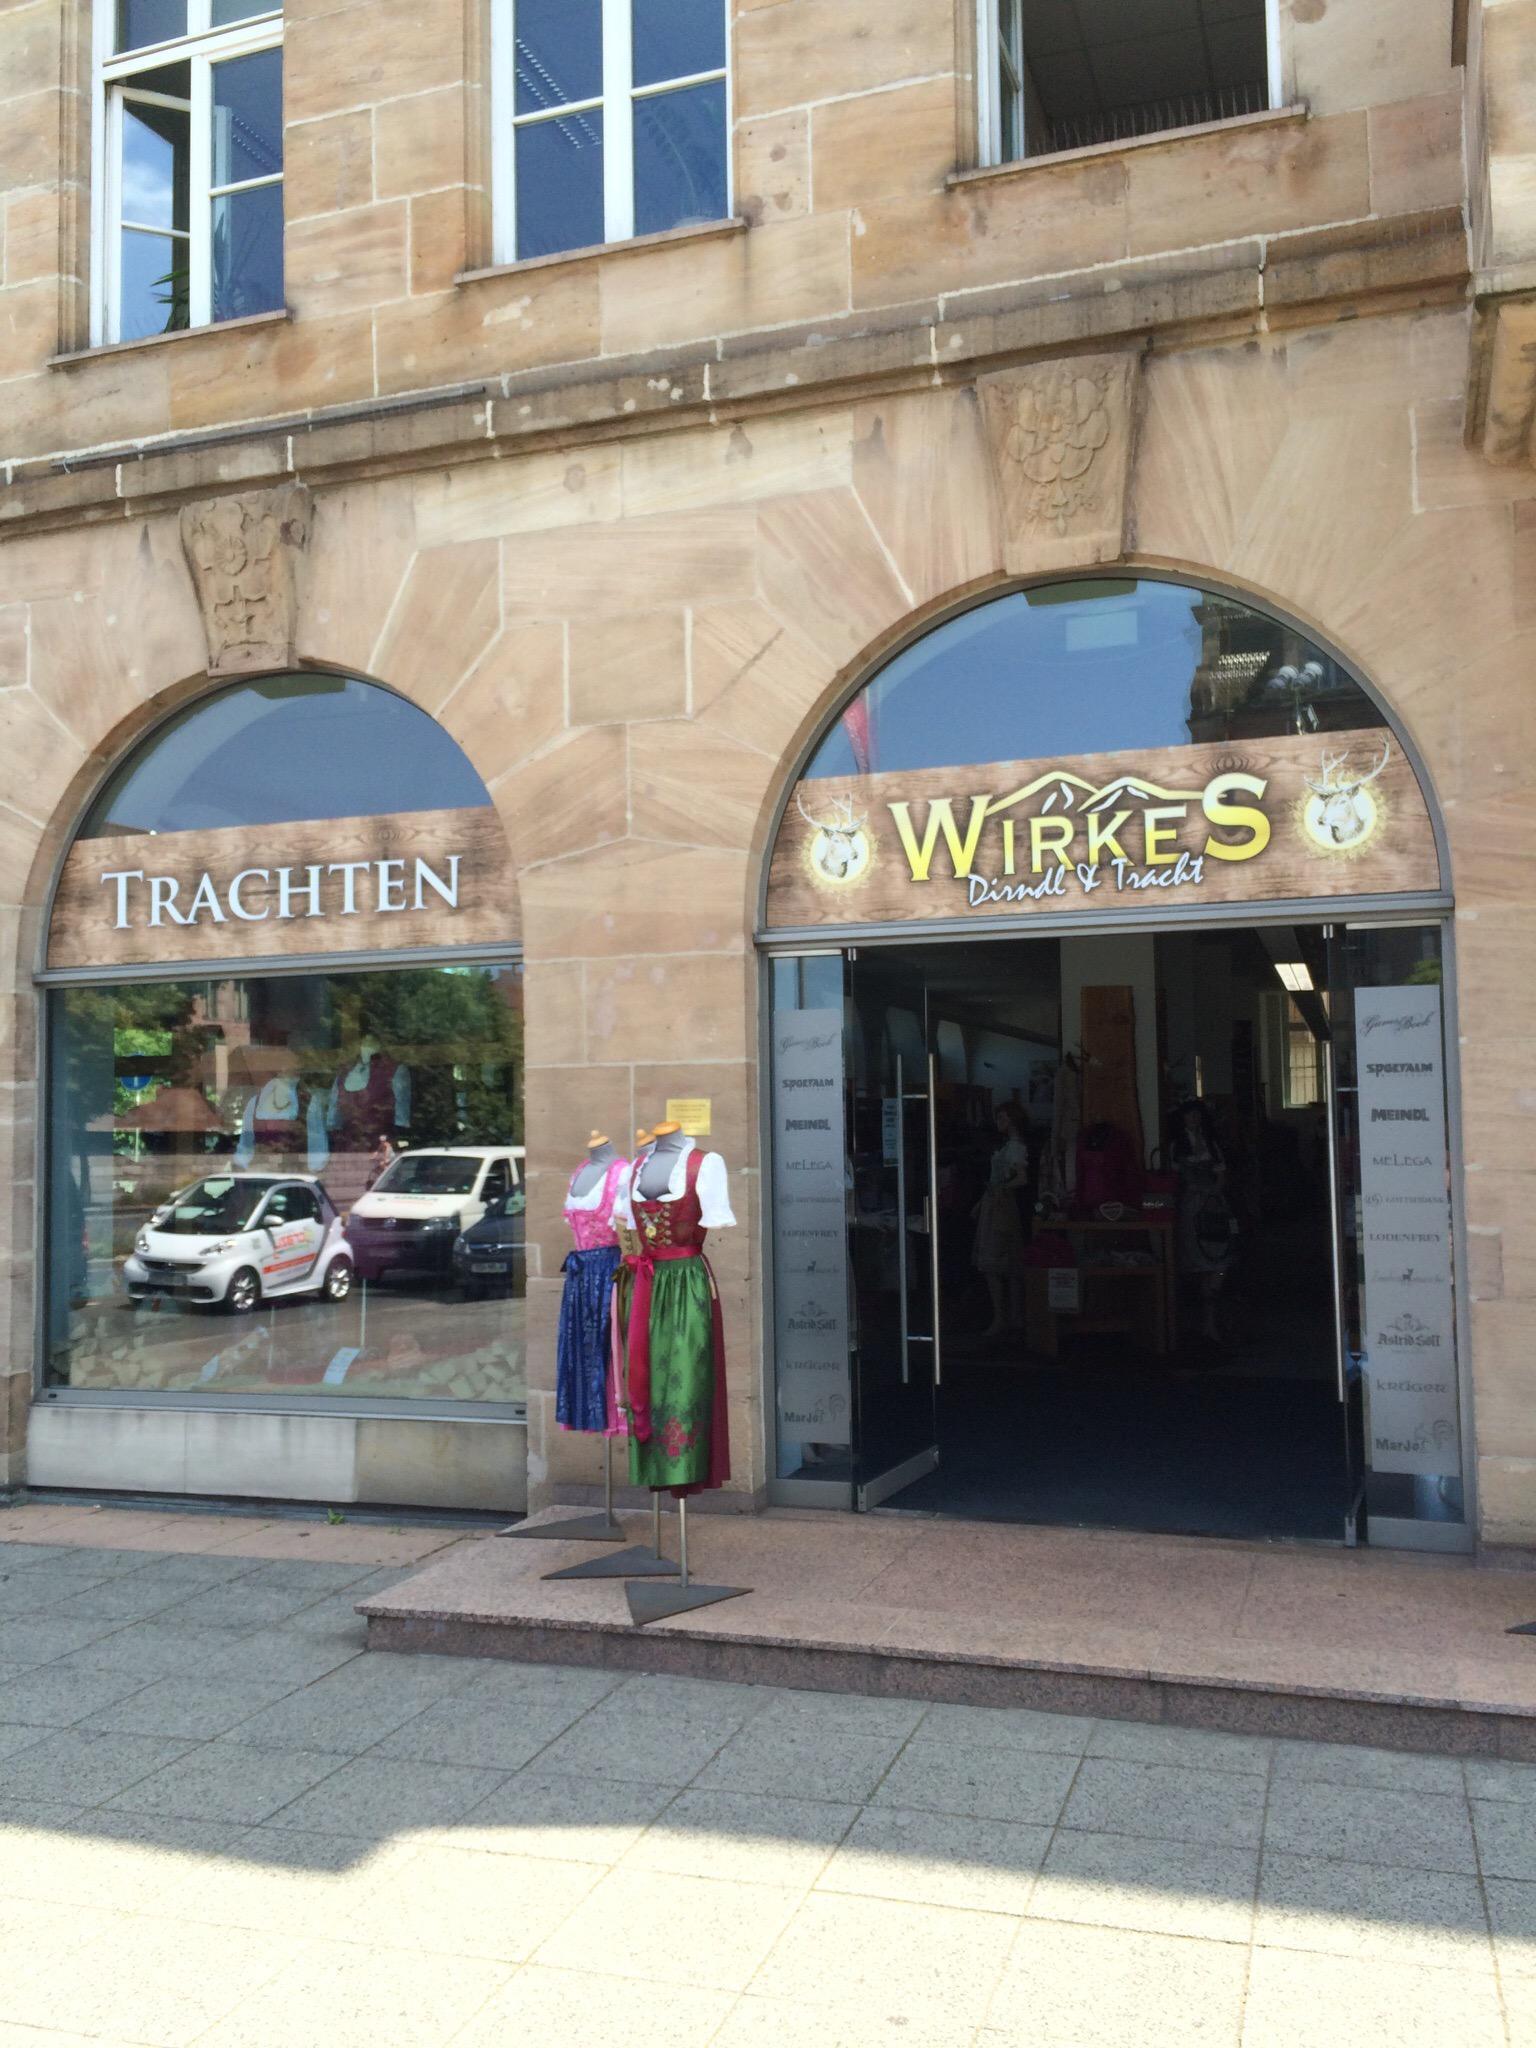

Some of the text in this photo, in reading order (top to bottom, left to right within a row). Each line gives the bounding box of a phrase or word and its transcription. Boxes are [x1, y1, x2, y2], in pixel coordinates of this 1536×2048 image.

[887, 772, 1272, 883] WIRKES
[101, 855, 463, 930] TRACHTEN
[967, 851, 1205, 908] Dirndl & Tracht
[784, 1118, 832, 1132] MEINDL
[1371, 1107, 1431, 1123] MEINDL
